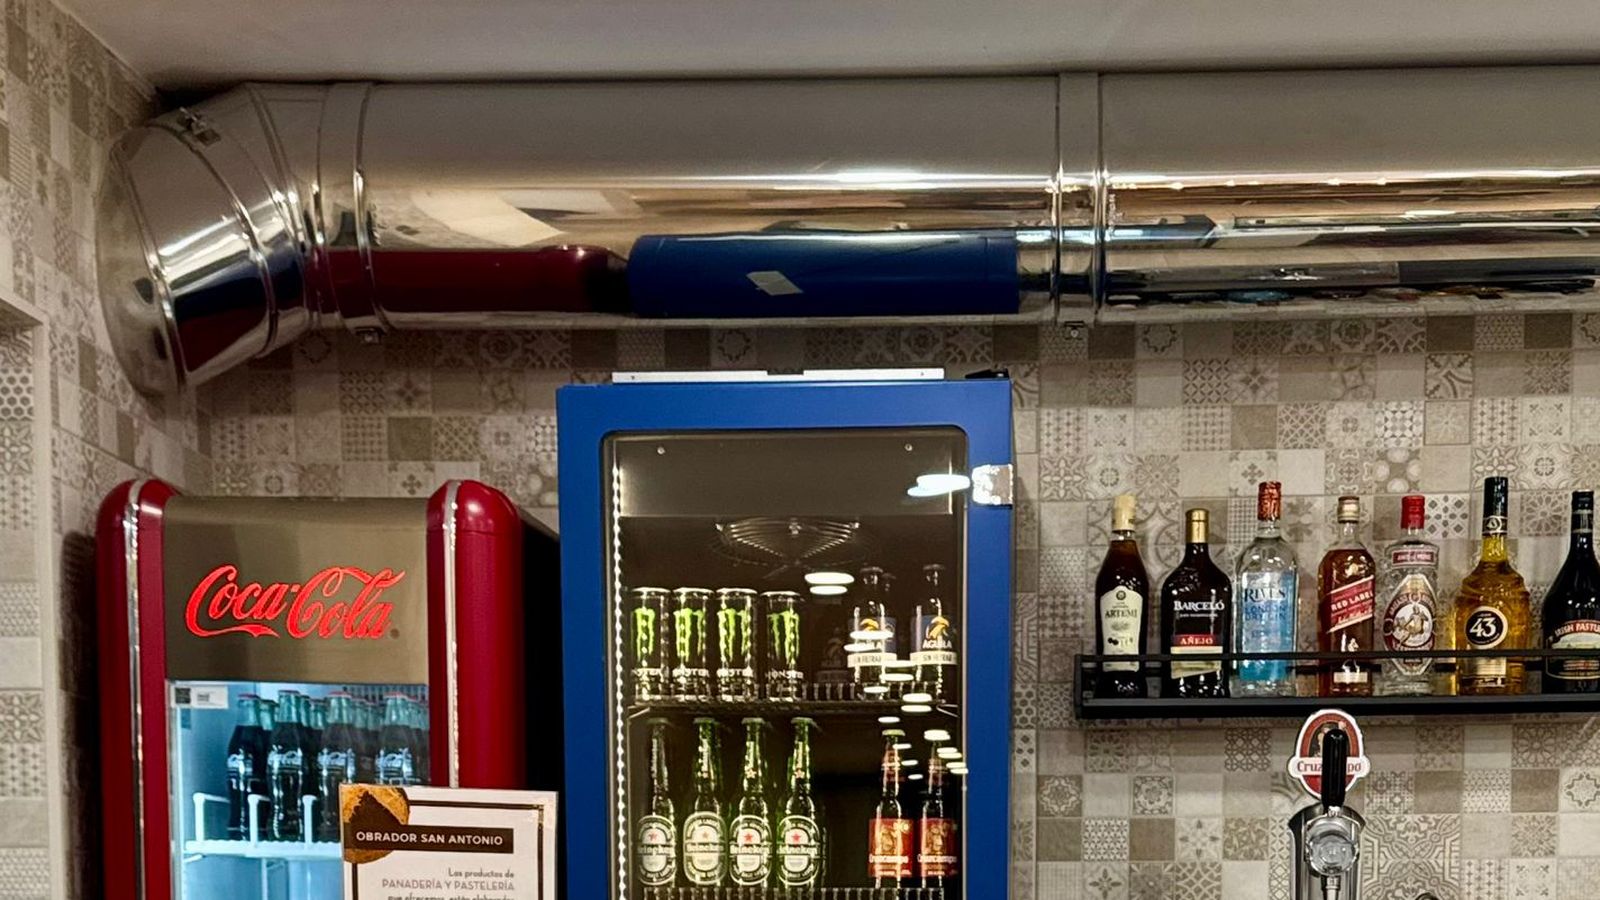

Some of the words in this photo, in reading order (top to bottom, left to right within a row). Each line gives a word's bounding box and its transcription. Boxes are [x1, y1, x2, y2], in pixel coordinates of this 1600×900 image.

[185, 563, 405, 640] Coca-Cola
[1174, 599, 1225, 612] BARCELÓ
[1330, 599, 1348, 611] RED
[1350, 591, 1373, 605] LABEL
[1105, 609, 1138, 619] ARTEMI
[1469, 616, 1497, 638] 43
[1180, 635, 1213, 646] AÑEJO
[1297, 760, 1361, 775] Cruzpo
[356, 831, 418, 844] OBRADOR
[420, 834, 445, 844] SAN
[448, 834, 503, 847] ANTONIO
[448, 868, 463, 878] Los
[465, 869, 503, 879] productos
[504, 869, 514, 879] de
[382, 878, 442, 890] PANADERÍA
[445, 881, 452, 889] Y
[454, 879, 515, 892] PASTELERÍA
